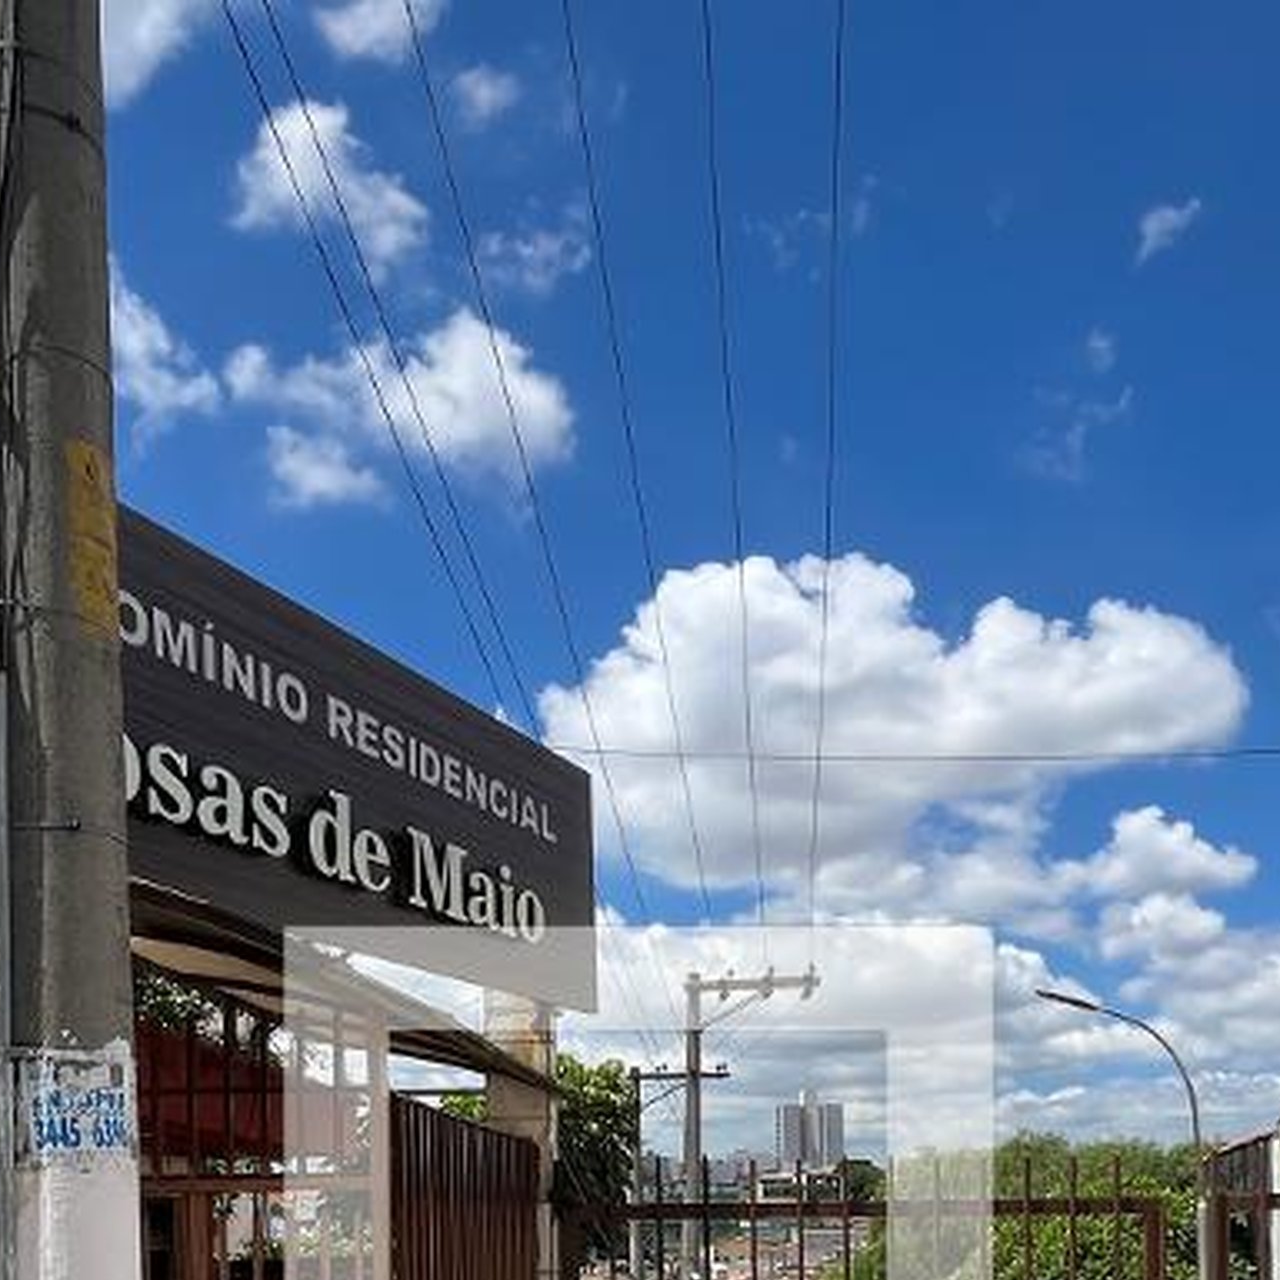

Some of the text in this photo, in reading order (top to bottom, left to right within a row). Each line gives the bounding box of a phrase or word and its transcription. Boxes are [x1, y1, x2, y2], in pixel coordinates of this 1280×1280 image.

[327, 694, 557, 843] RESIDENCIAL
[309, 789, 391, 892] de
[407, 826, 545, 943] Maio
